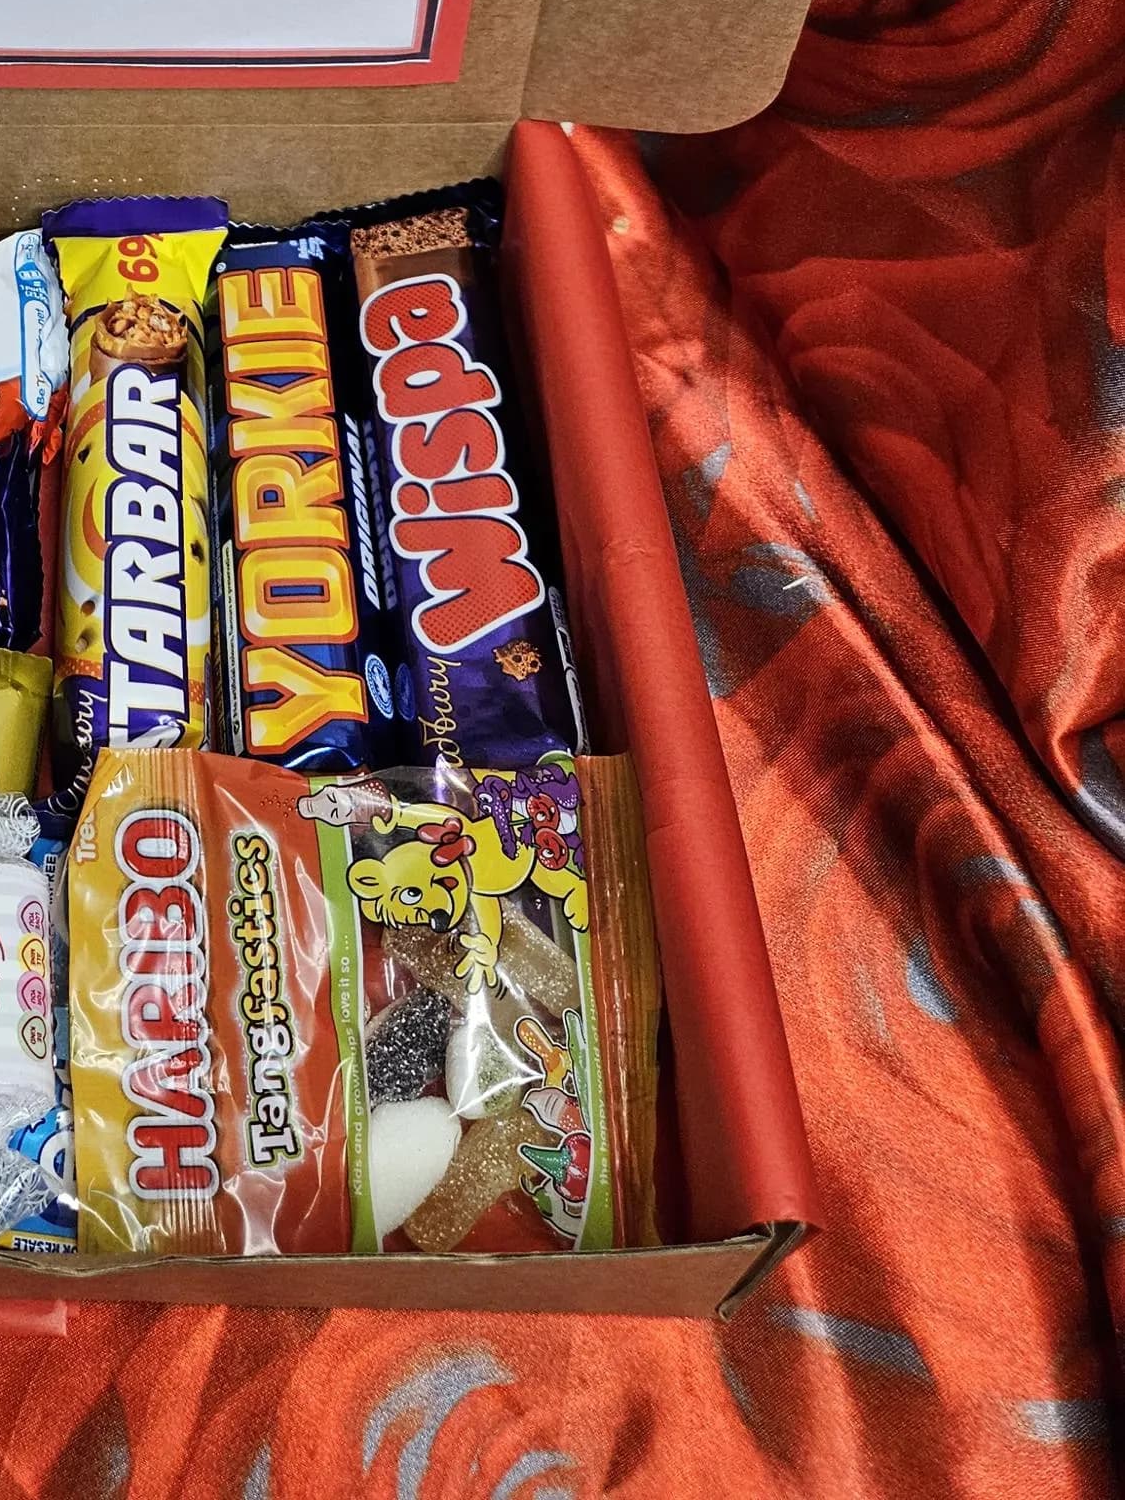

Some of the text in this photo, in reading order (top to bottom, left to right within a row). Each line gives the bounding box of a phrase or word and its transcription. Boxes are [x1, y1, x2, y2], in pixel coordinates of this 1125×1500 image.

[218, 267, 369, 760] YORKIE
[343, 412, 380, 610] ORIGINAL
[360, 274, 544, 654] Wispa
[416, 656, 464, 769] adbury
[115, 808, 220, 1201] HARIBO
[230, 831, 302, 1167] Tangfastics
[338, 978, 350, 987] it
[339, 992, 351, 1023] love
[340, 956, 350, 973] so
[353, 1122, 364, 1154] and
[354, 1160, 363, 1195] Kids
